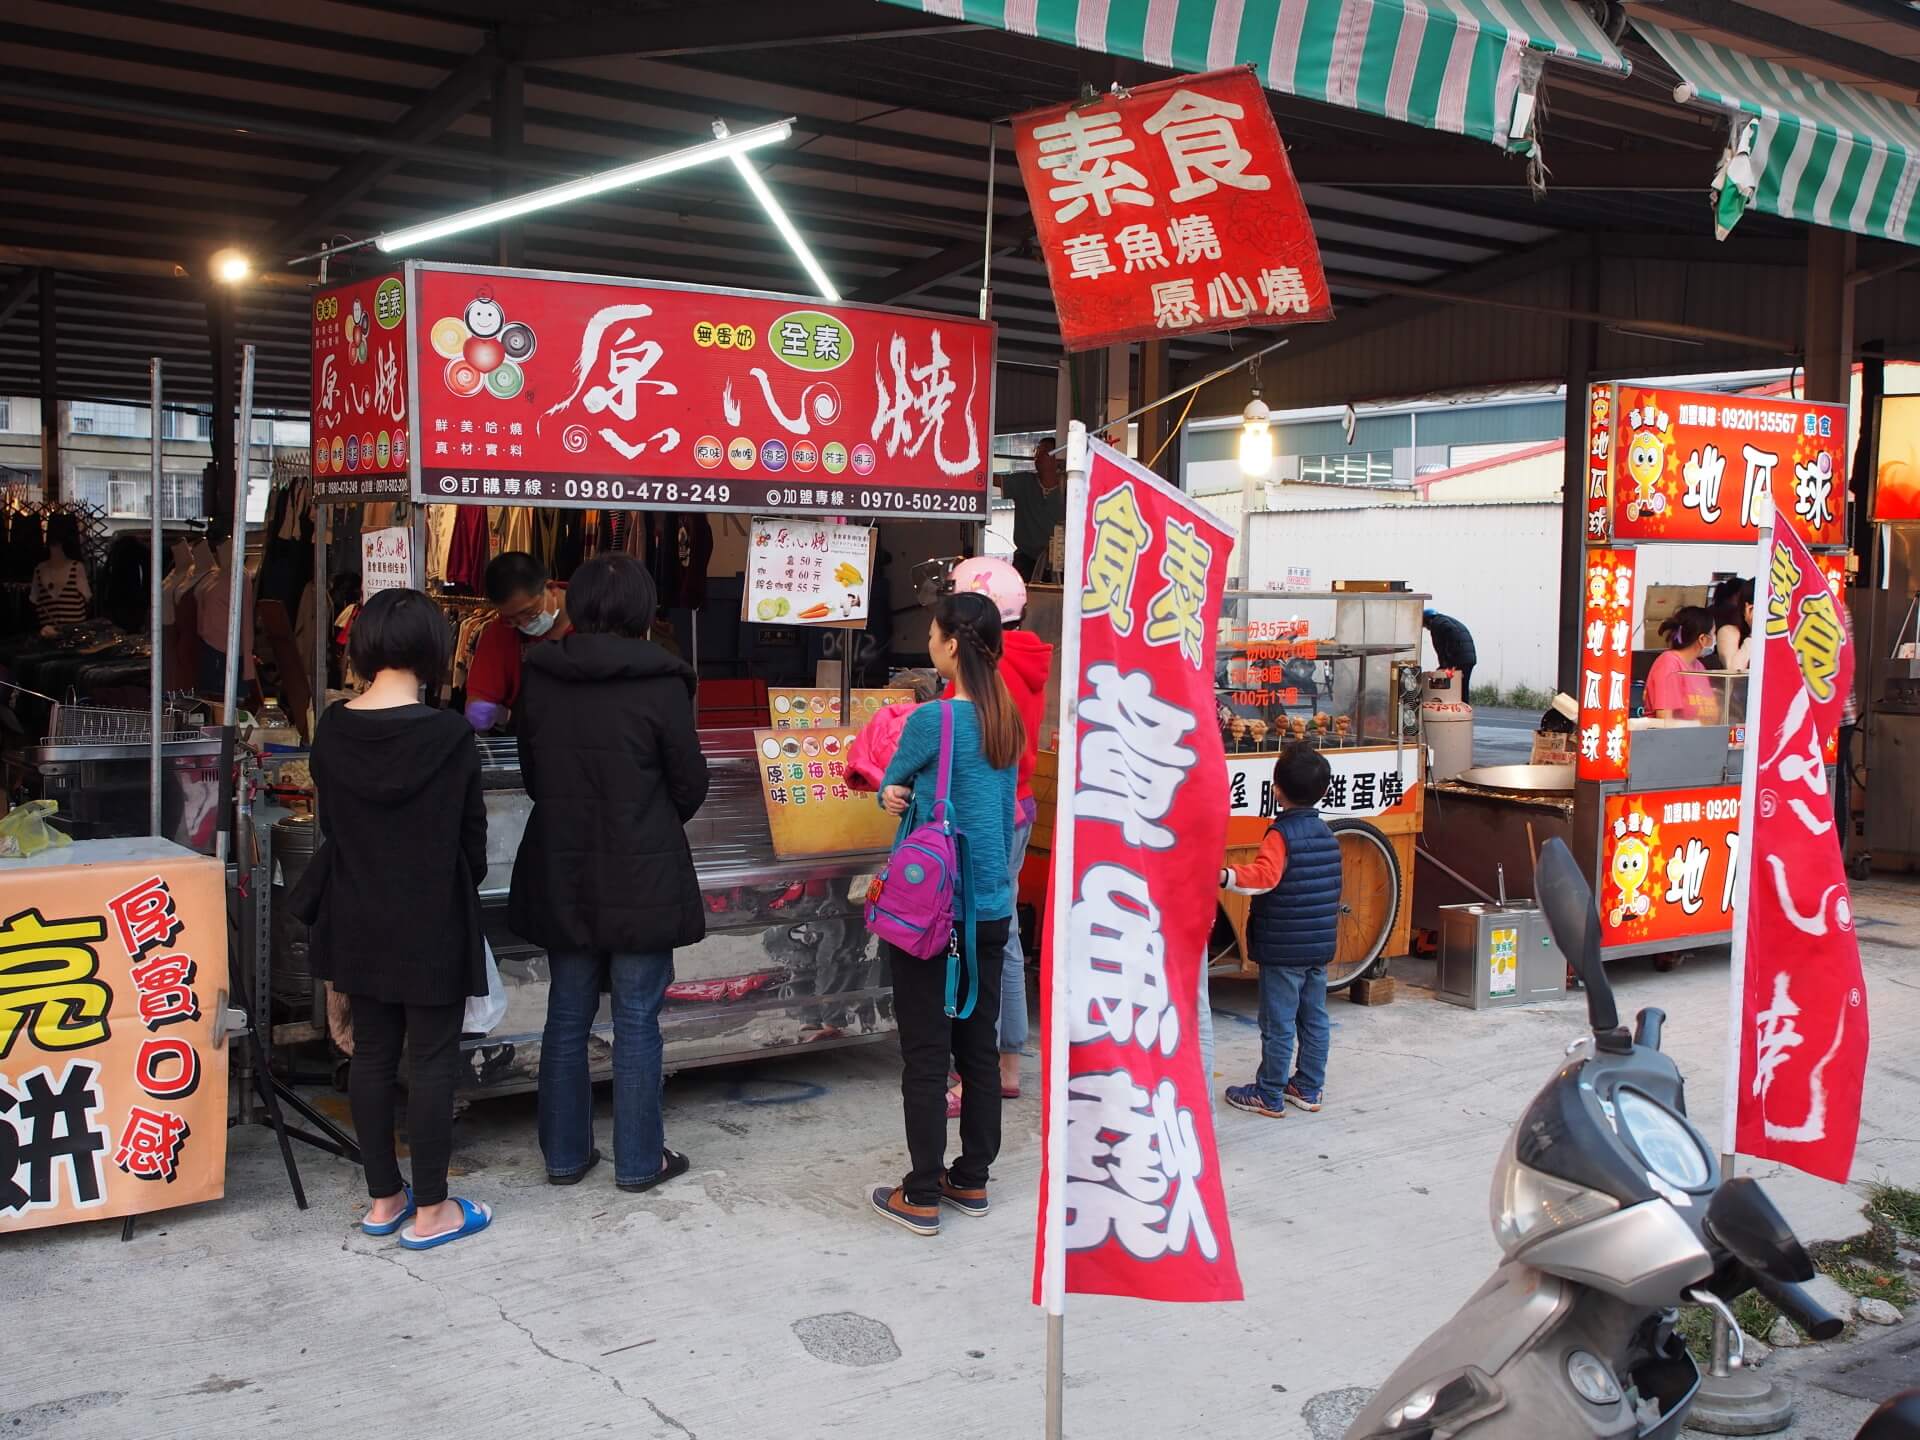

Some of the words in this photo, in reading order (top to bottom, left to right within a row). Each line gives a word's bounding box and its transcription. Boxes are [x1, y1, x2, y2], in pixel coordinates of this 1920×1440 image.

[1033, 89, 1271, 223] 素食
[1063, 213, 1222, 280] 章魚燒
[378, 287, 401, 320] 全素
[1151, 265, 1310, 329] 愿心燒
[696, 326, 752, 347] 無蛋奶
[781, 322, 841, 361] 全素
[1803, 413, 1831, 437] 素食
[696, 446, 721, 458] 原味
[794, 451, 816, 463] 辣味
[1588, 430, 1609, 540] 地瓜球
[1683, 443, 1833, 530] 地瓜球
[1582, 619, 1607, 762] 地瓜球
[1606, 619, 1631, 762] 地瓜球
[767, 764, 788, 804] 原味
[787, 763, 807, 805] 海苔
[827, 760, 849, 800] 辣味
[107, 875, 200, 1184] 厚實口感
